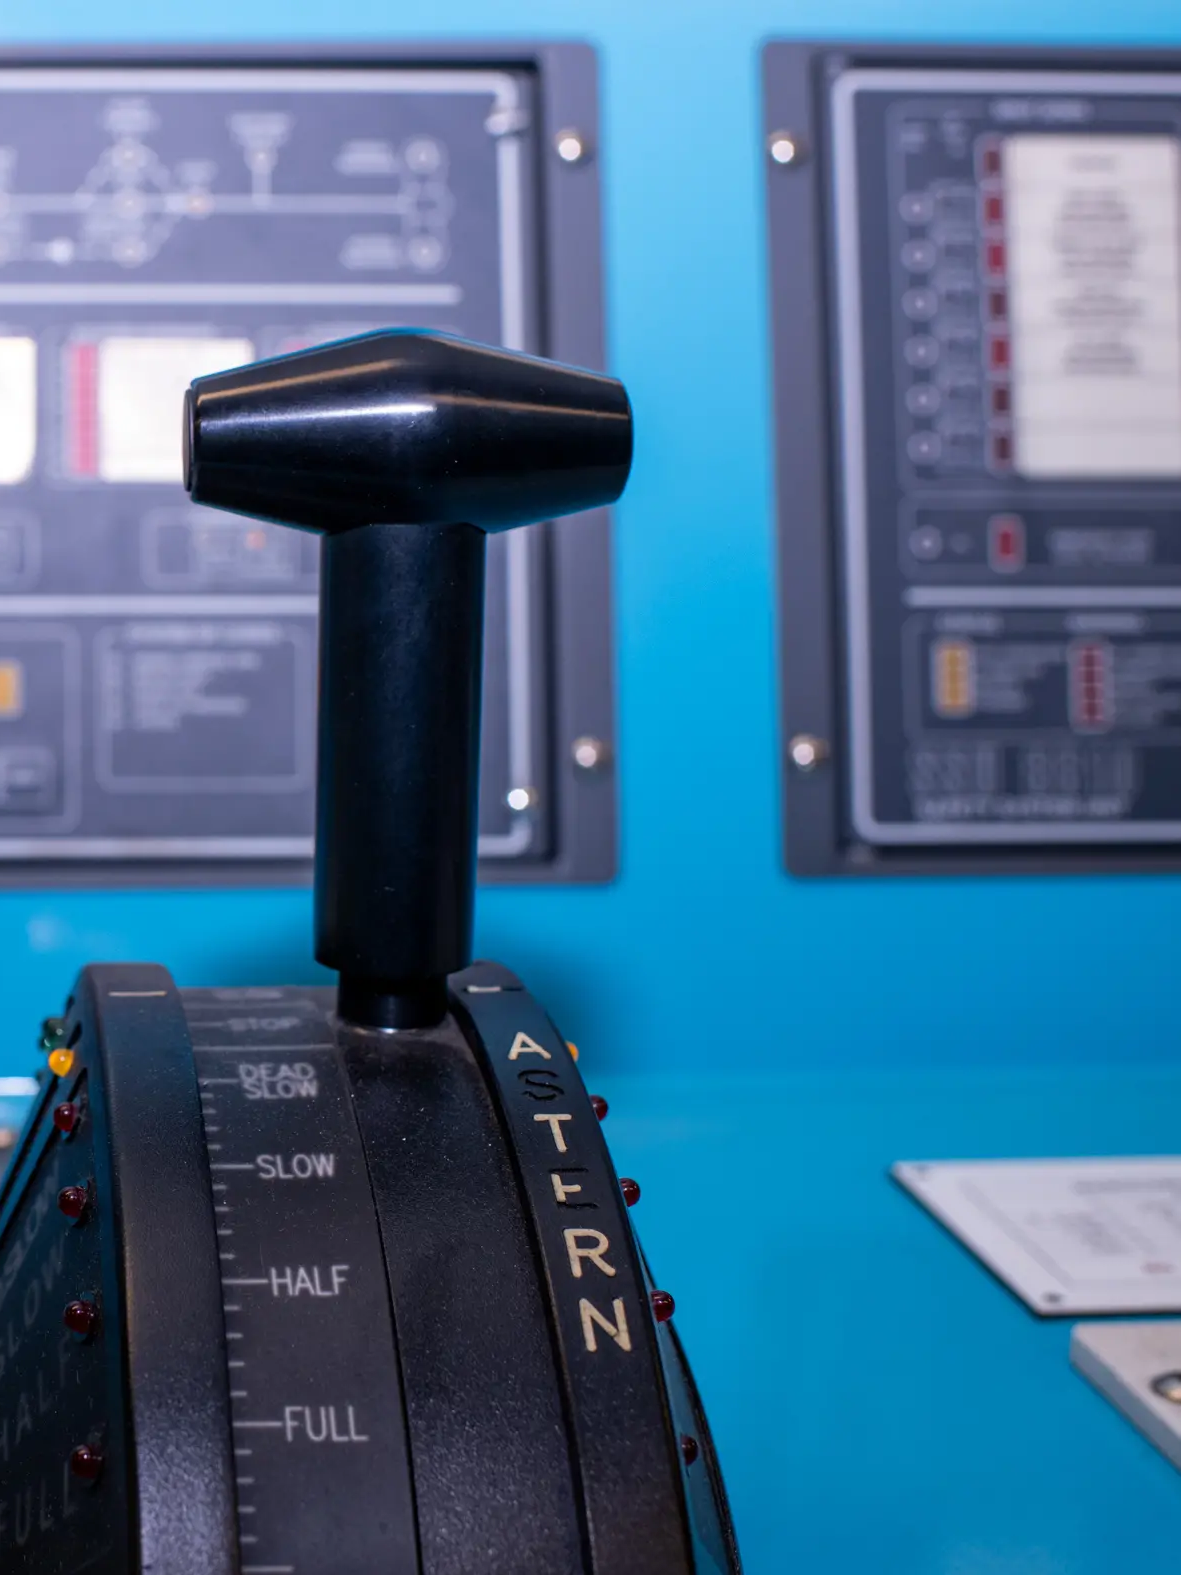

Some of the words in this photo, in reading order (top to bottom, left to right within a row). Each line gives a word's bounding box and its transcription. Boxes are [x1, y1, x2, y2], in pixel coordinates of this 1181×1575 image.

[228, 1017, 300, 1031] STOP
[239, 1062, 316, 1081] DEAD
[243, 1079, 319, 1099] SLOW
[256, 1153, 336, 1180] SLOW
[507, 1031, 633, 1353] ASTERN
[270, 1264, 350, 1297] HALF
[283, 1405, 369, 1442] FULL
